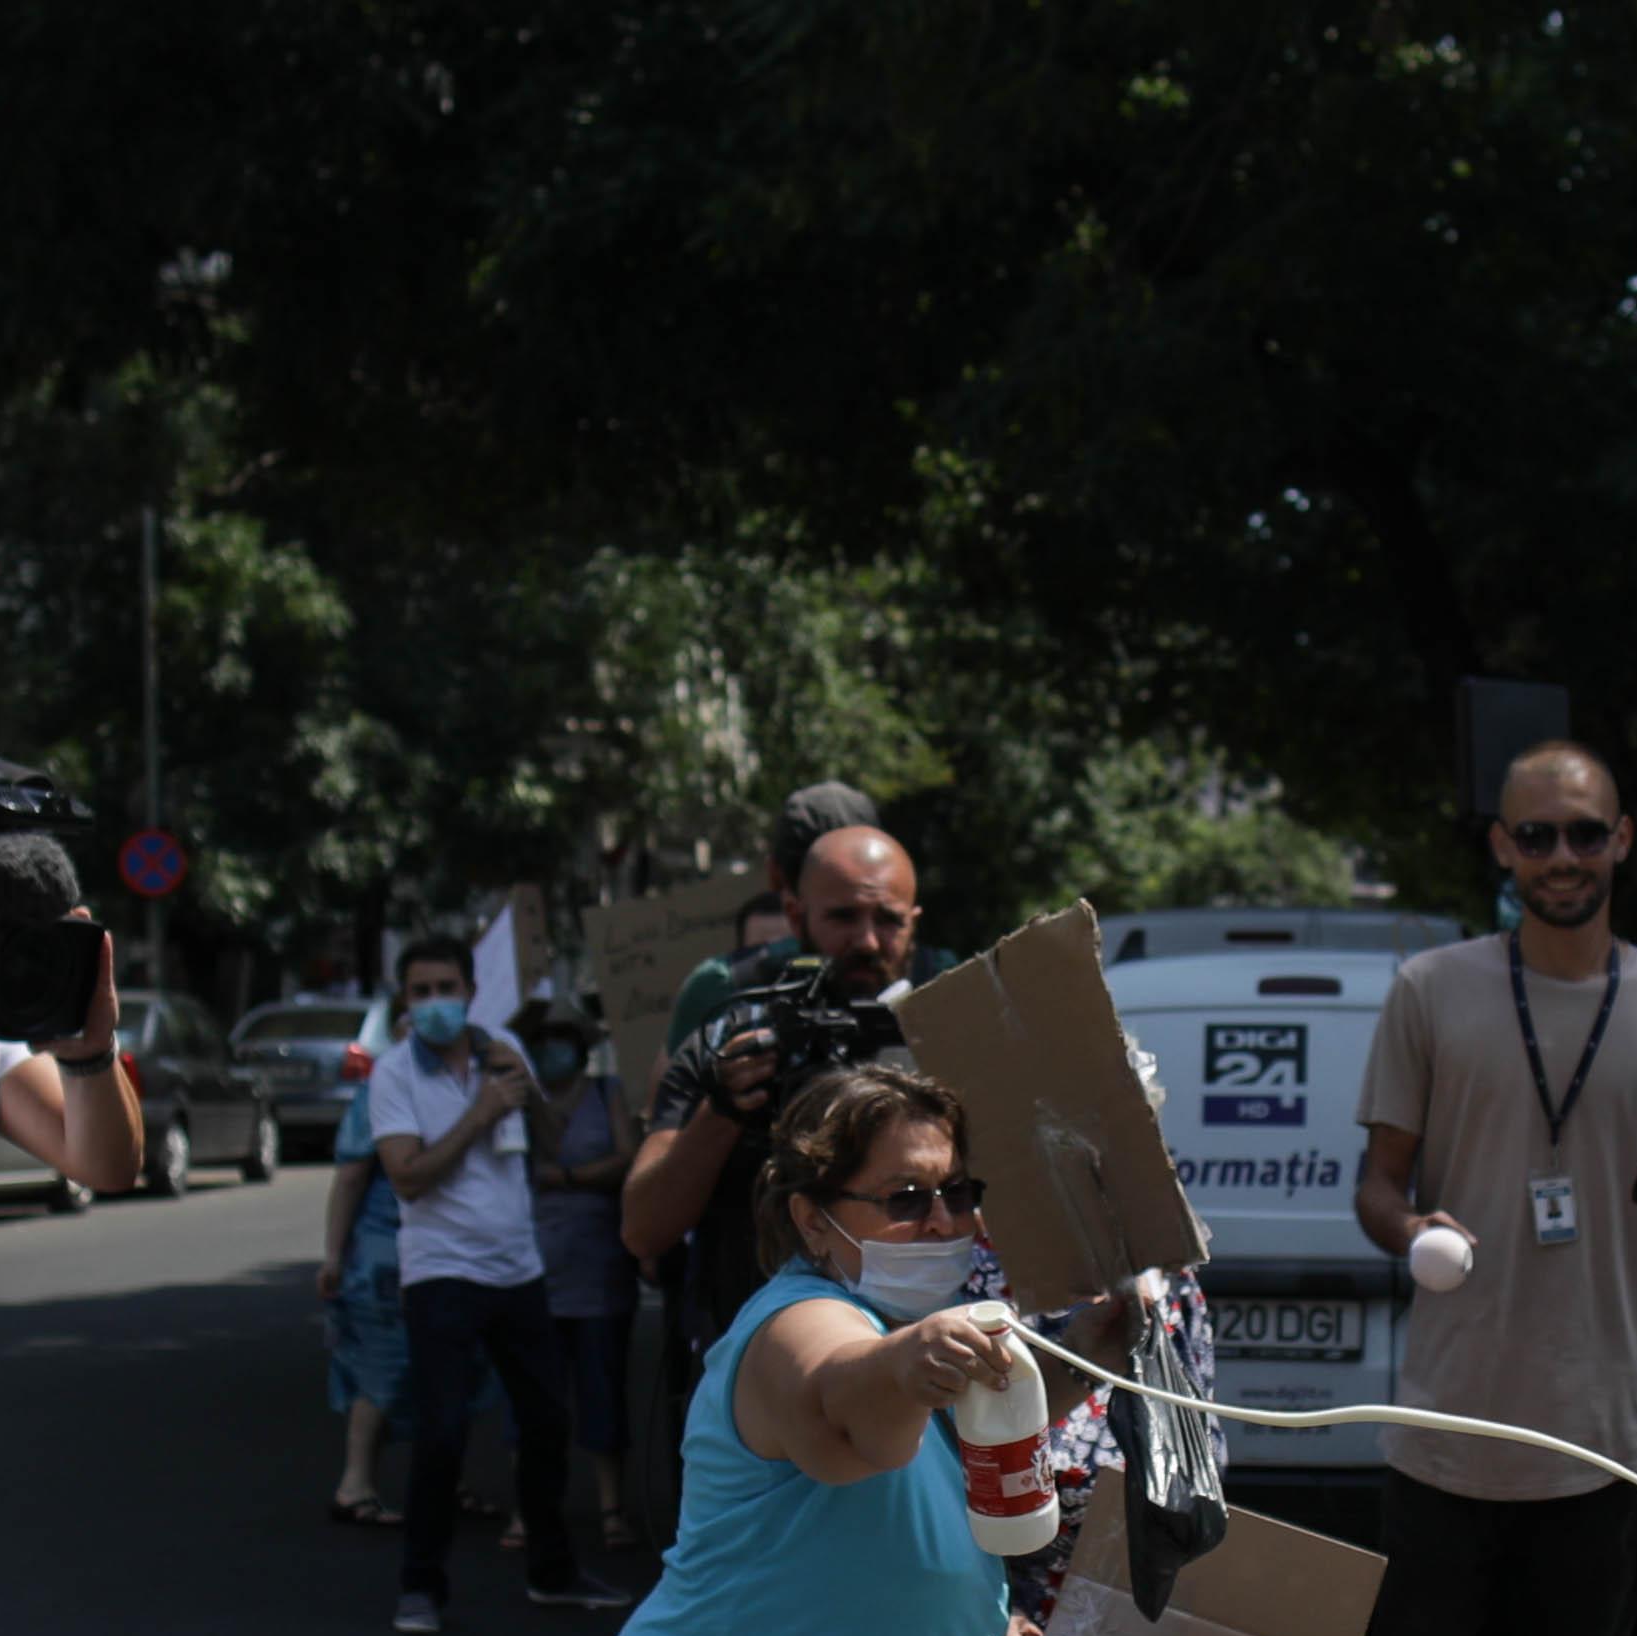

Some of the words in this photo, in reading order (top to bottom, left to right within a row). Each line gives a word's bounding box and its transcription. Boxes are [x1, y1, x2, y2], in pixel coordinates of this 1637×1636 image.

[1215, 1028, 1300, 1049] DIGI
[1213, 1051, 1298, 1109] 24
[1237, 1102, 1271, 1120] HD
[1172, 1149, 1343, 1198] ormația
[1275, 1304, 1343, 1344] DGI
